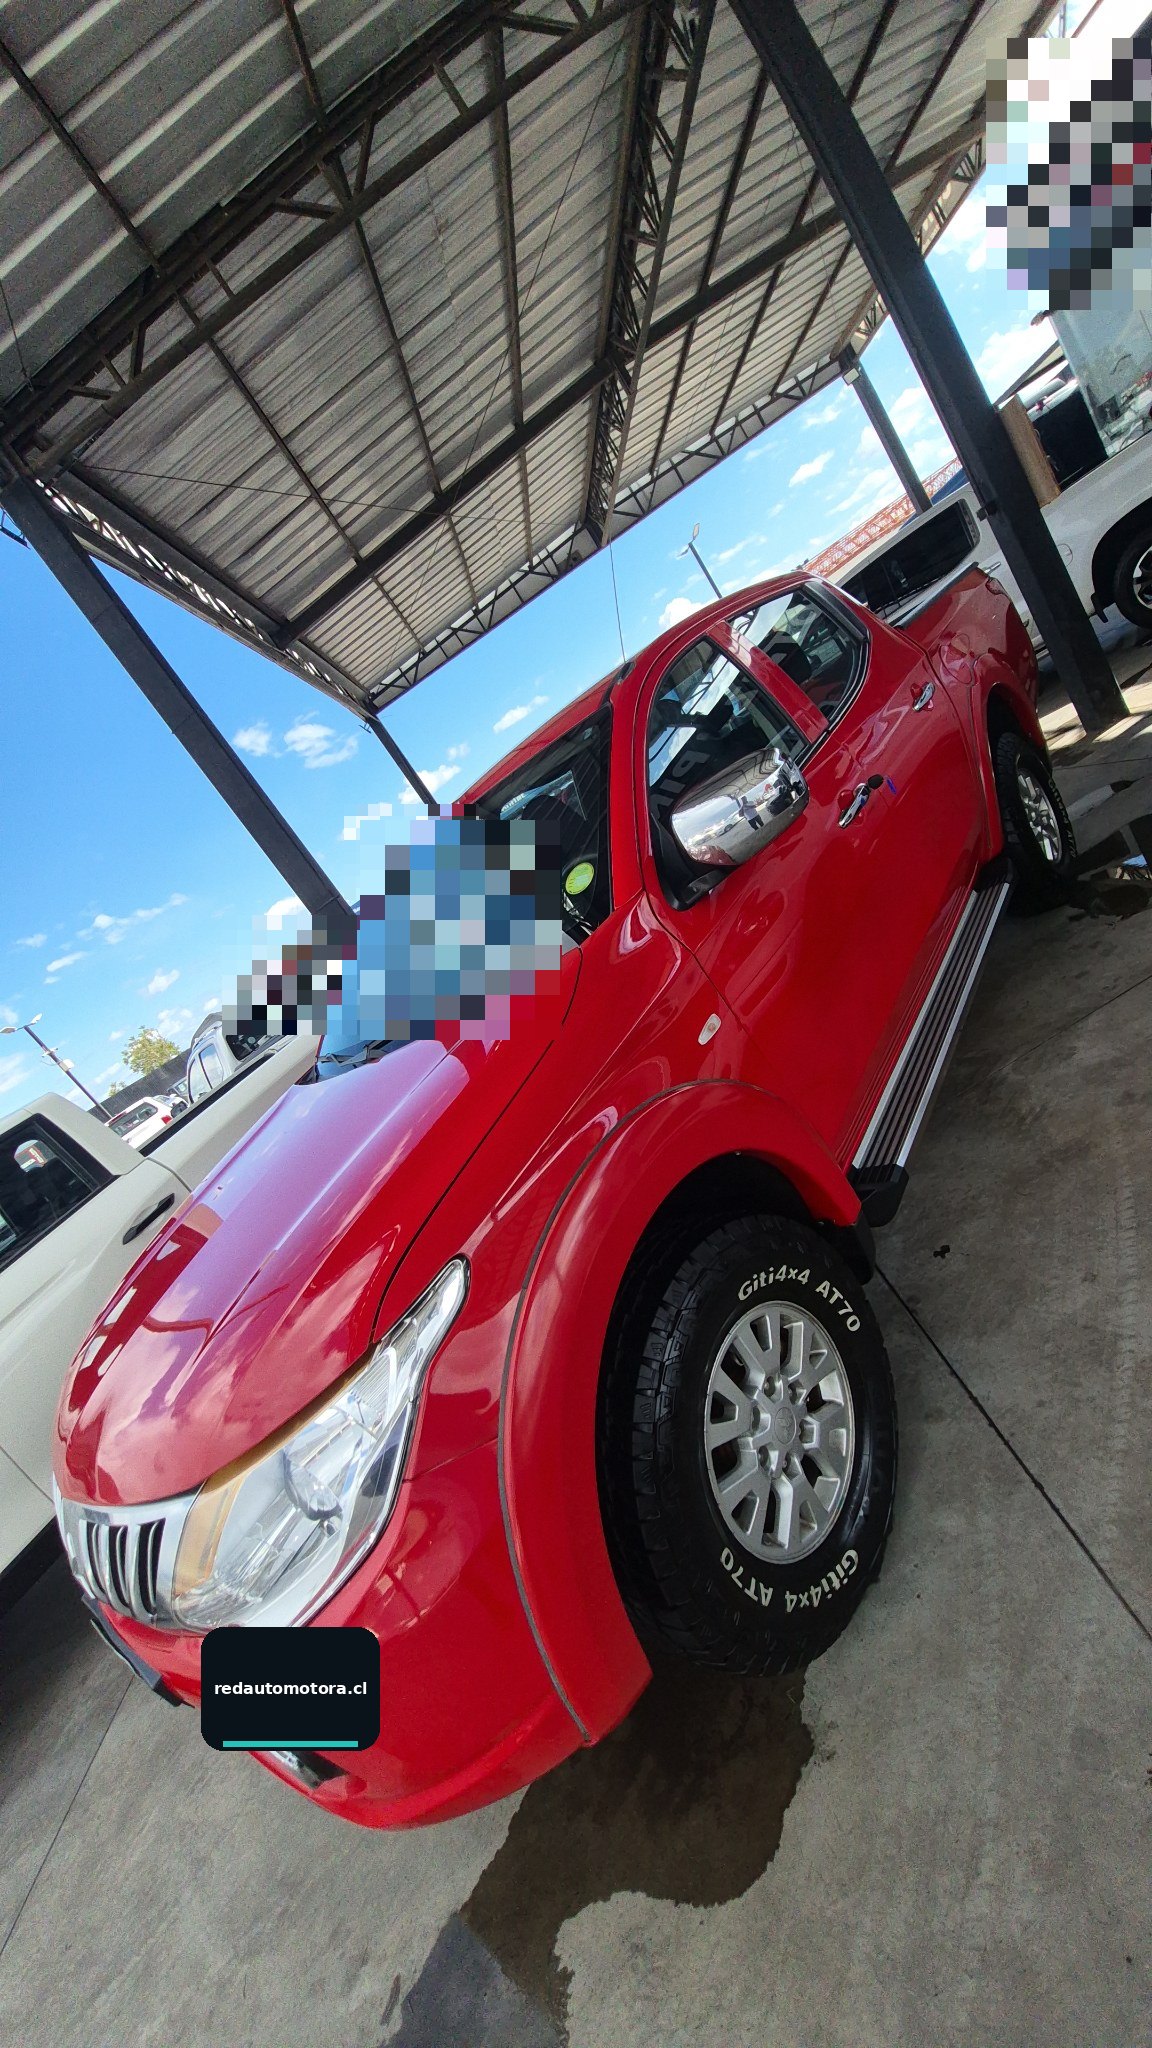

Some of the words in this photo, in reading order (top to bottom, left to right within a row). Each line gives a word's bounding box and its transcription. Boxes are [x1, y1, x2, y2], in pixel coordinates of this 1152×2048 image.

[738, 1264, 811, 1301] Giti4x4
[814, 1280, 861, 1332] AT70
[720, 1547, 774, 1607] AT70
[784, 1549, 859, 1613] Giti4x4
